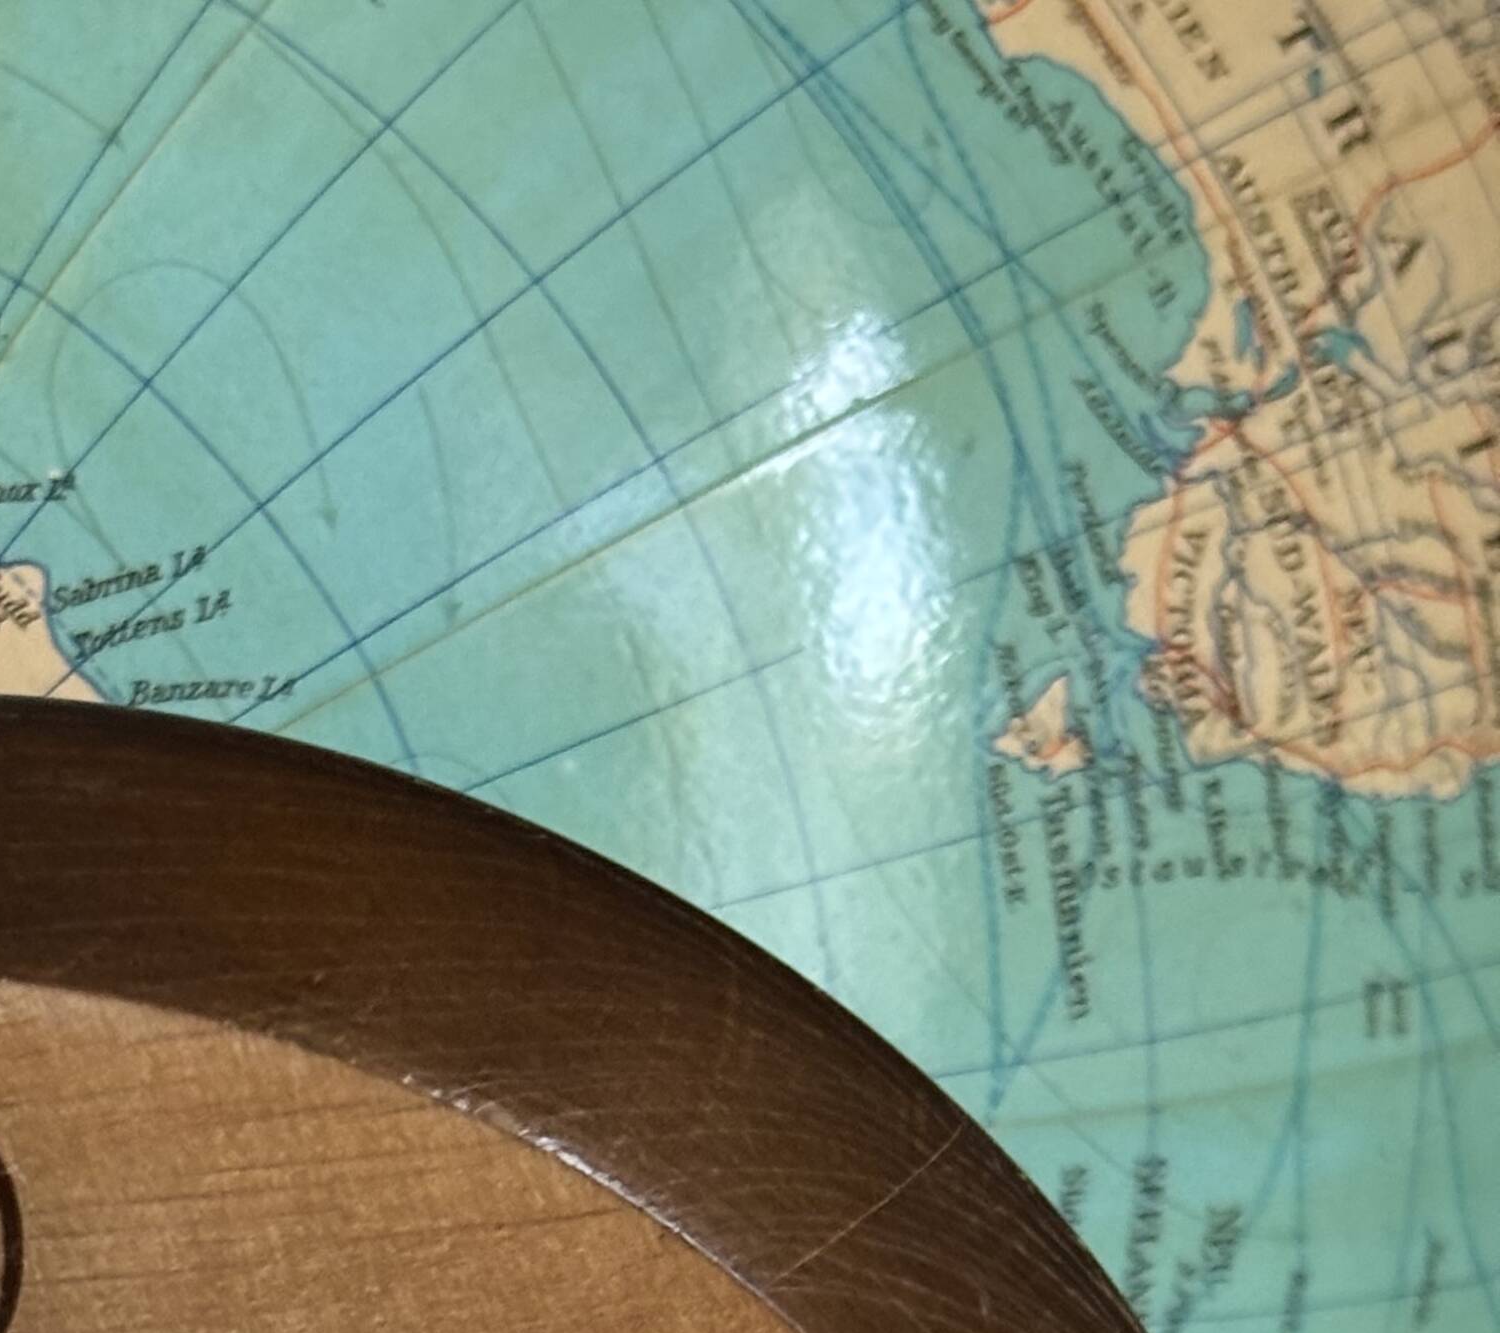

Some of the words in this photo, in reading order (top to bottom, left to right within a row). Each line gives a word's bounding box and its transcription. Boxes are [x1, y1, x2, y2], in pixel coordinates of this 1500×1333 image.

[50, 562, 164, 614] Sabrina
[127, 678, 255, 707] Banzare
[1040, 784, 1097, 1021] Tasmanien
